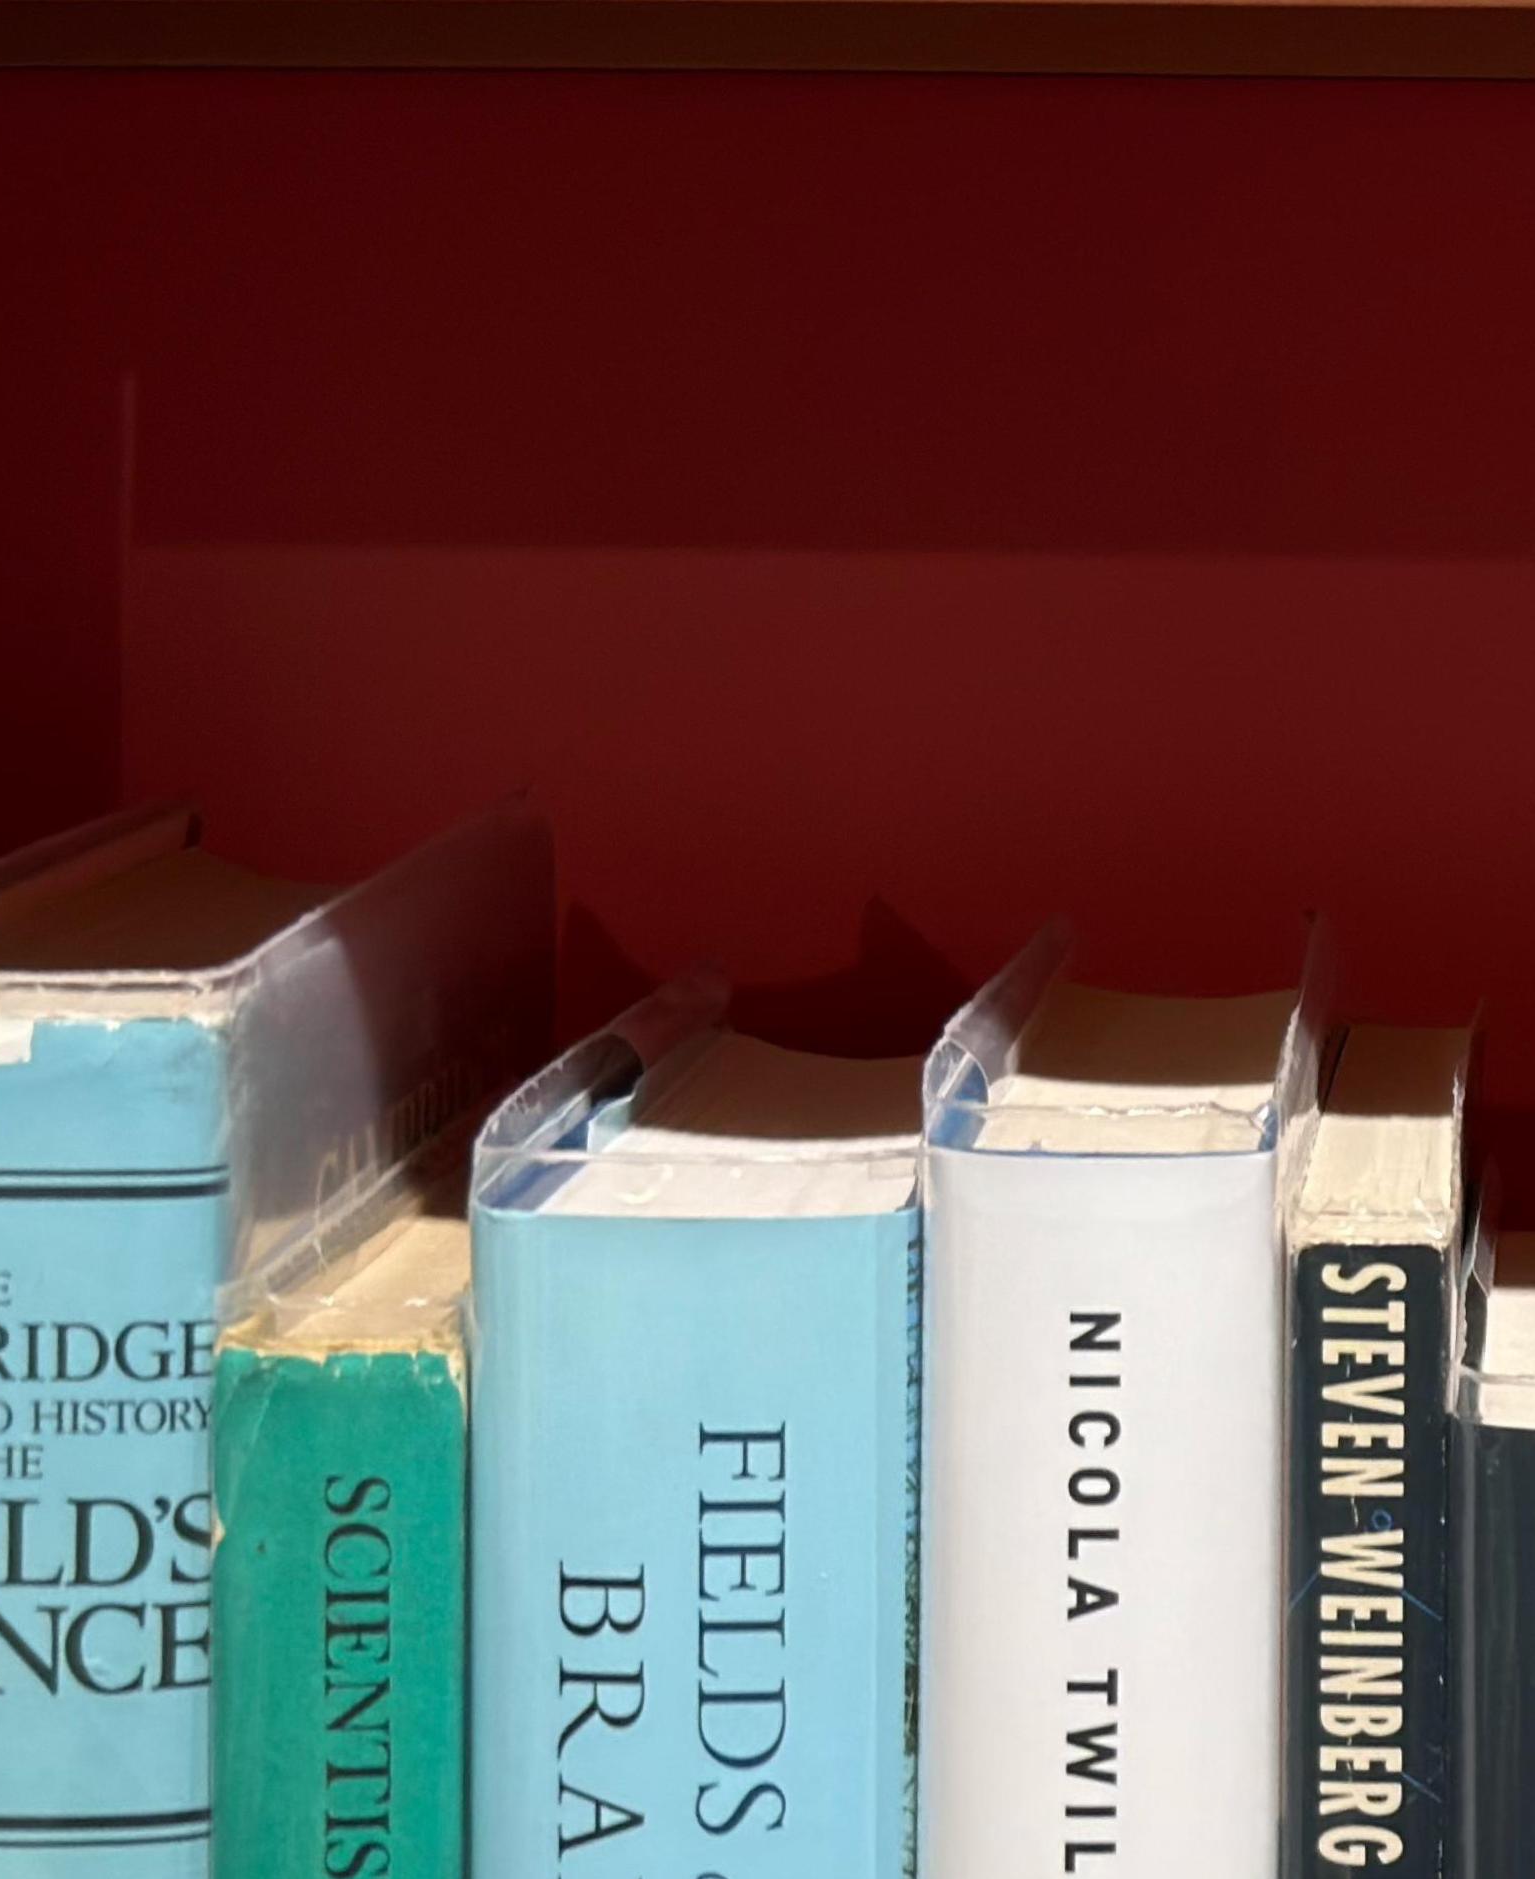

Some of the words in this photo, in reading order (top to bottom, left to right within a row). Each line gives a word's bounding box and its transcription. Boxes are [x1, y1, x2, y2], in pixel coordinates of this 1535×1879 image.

[33, 1398, 215, 1437] HISTORY
[1066, 1310, 1122, 1618] NICOLA
[1320, 1263, 1405, 1496] STEVEN
[692, 1421, 788, 1837] FIELDS
[1318, 1529, 1405, 1868] WEINBERG
